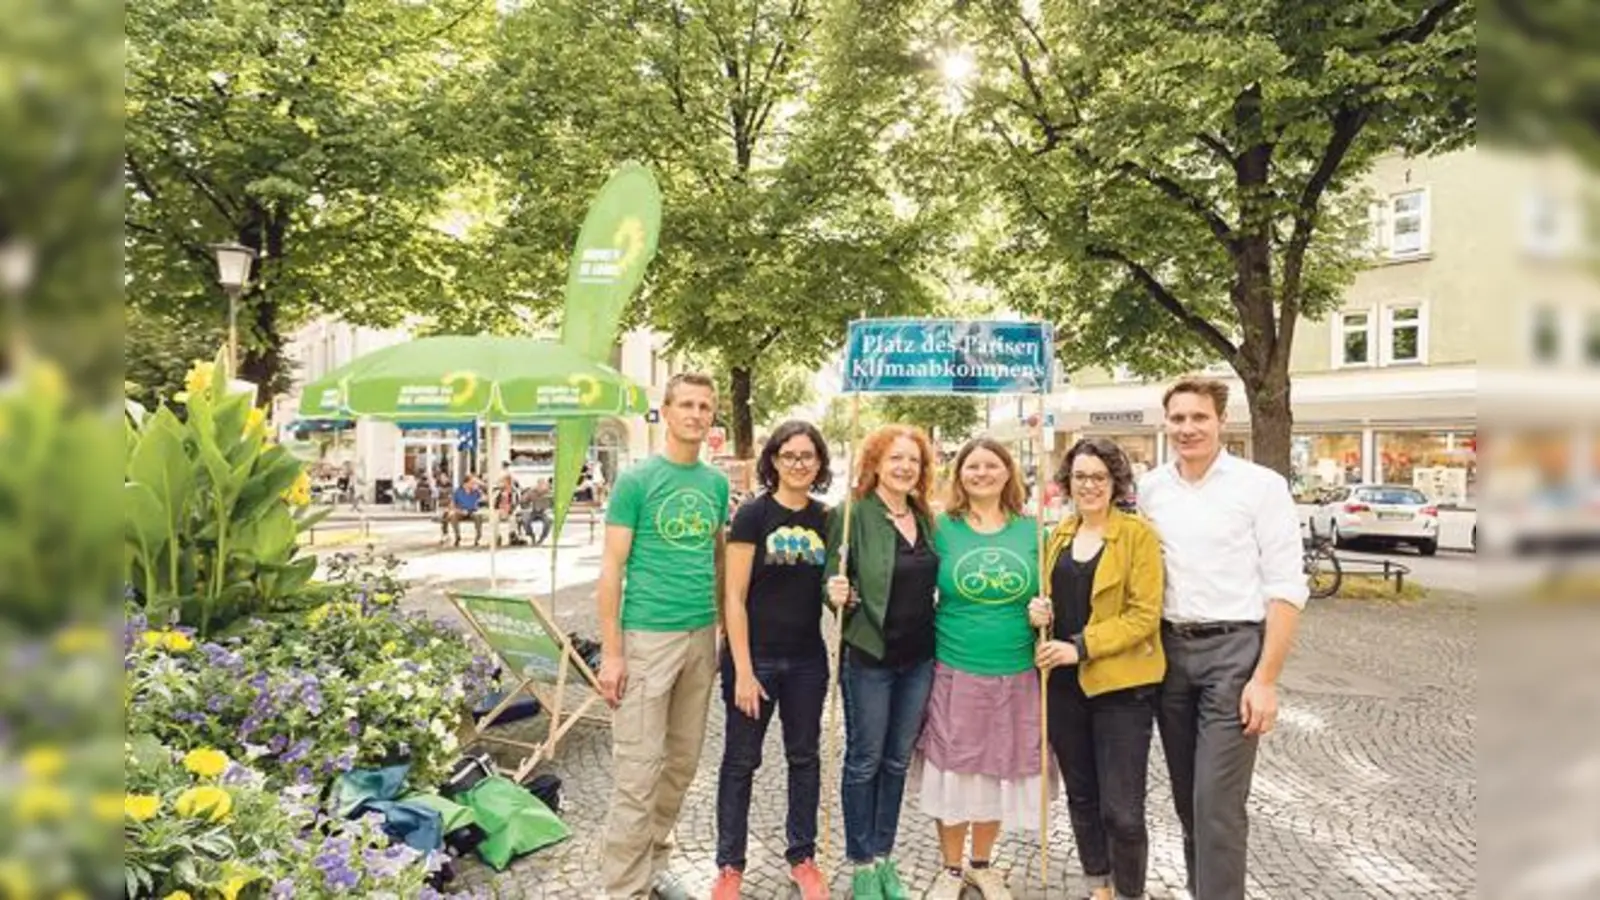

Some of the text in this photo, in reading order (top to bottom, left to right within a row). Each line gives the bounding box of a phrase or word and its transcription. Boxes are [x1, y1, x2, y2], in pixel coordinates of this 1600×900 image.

[862, 332, 1038, 355] Platz des Pariser
[852, 358, 1044, 379] Klimaabkommens
